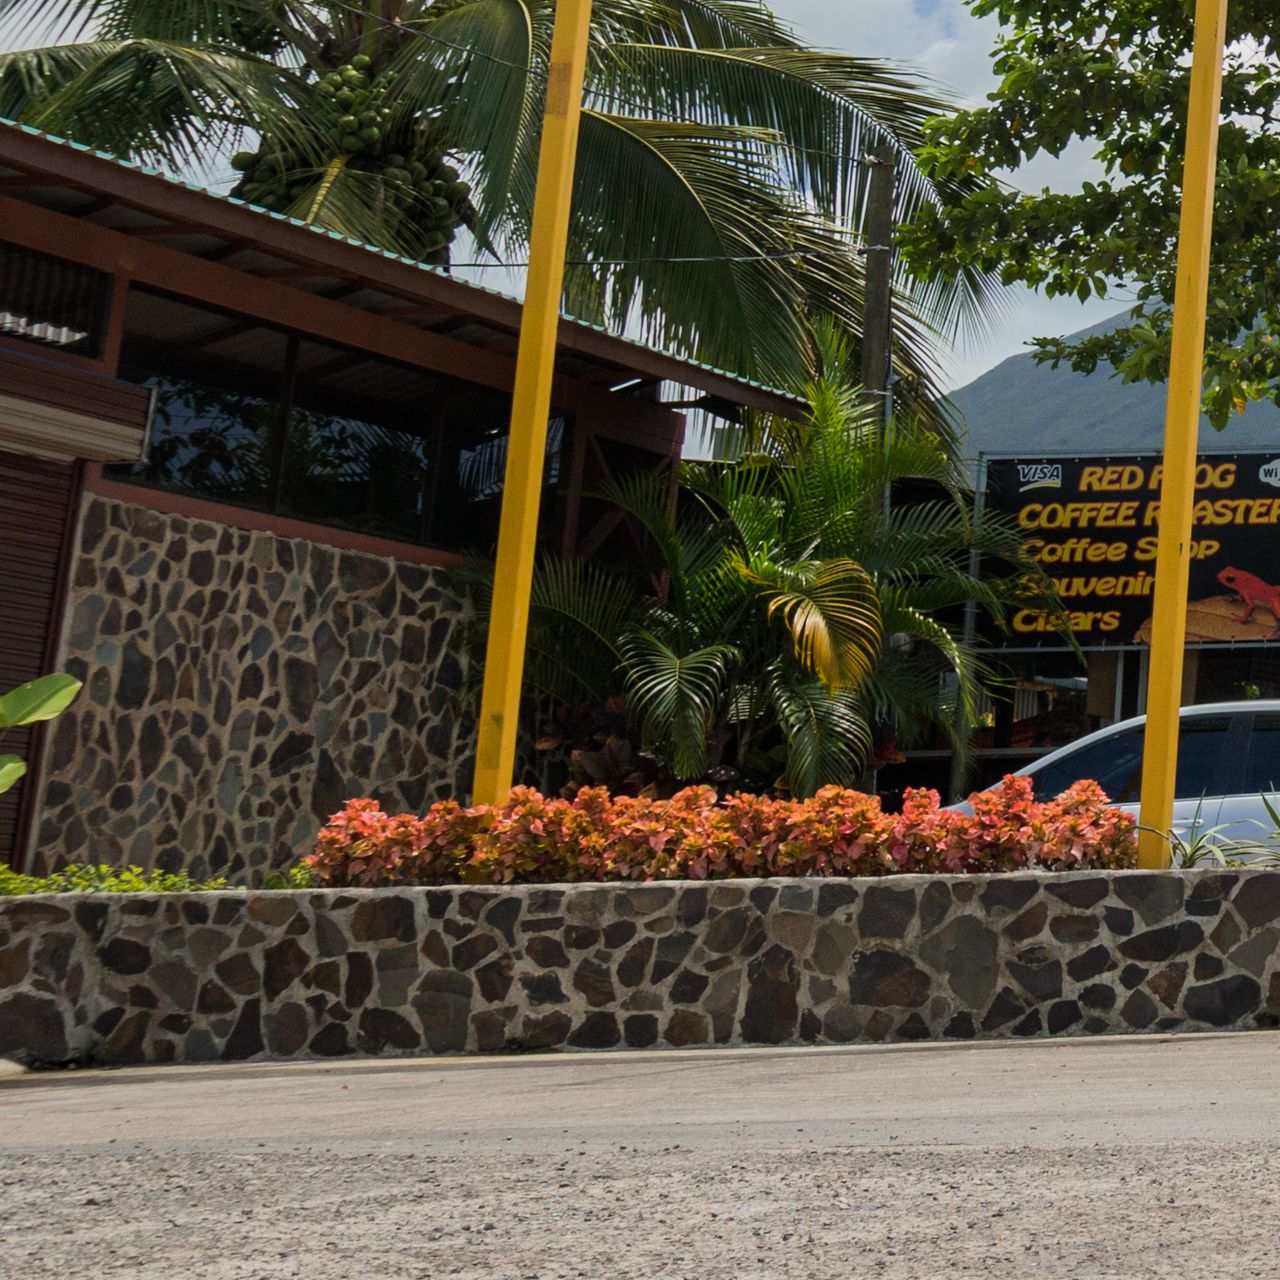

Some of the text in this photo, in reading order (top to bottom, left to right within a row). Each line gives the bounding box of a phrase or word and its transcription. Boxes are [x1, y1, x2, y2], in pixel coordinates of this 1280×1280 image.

[1018, 464, 1062, 482] VISA
[1079, 463, 1236, 491] RED FOG
[1017, 502, 1139, 529] COFFEE
[1019, 538, 1128, 563] Coffee
